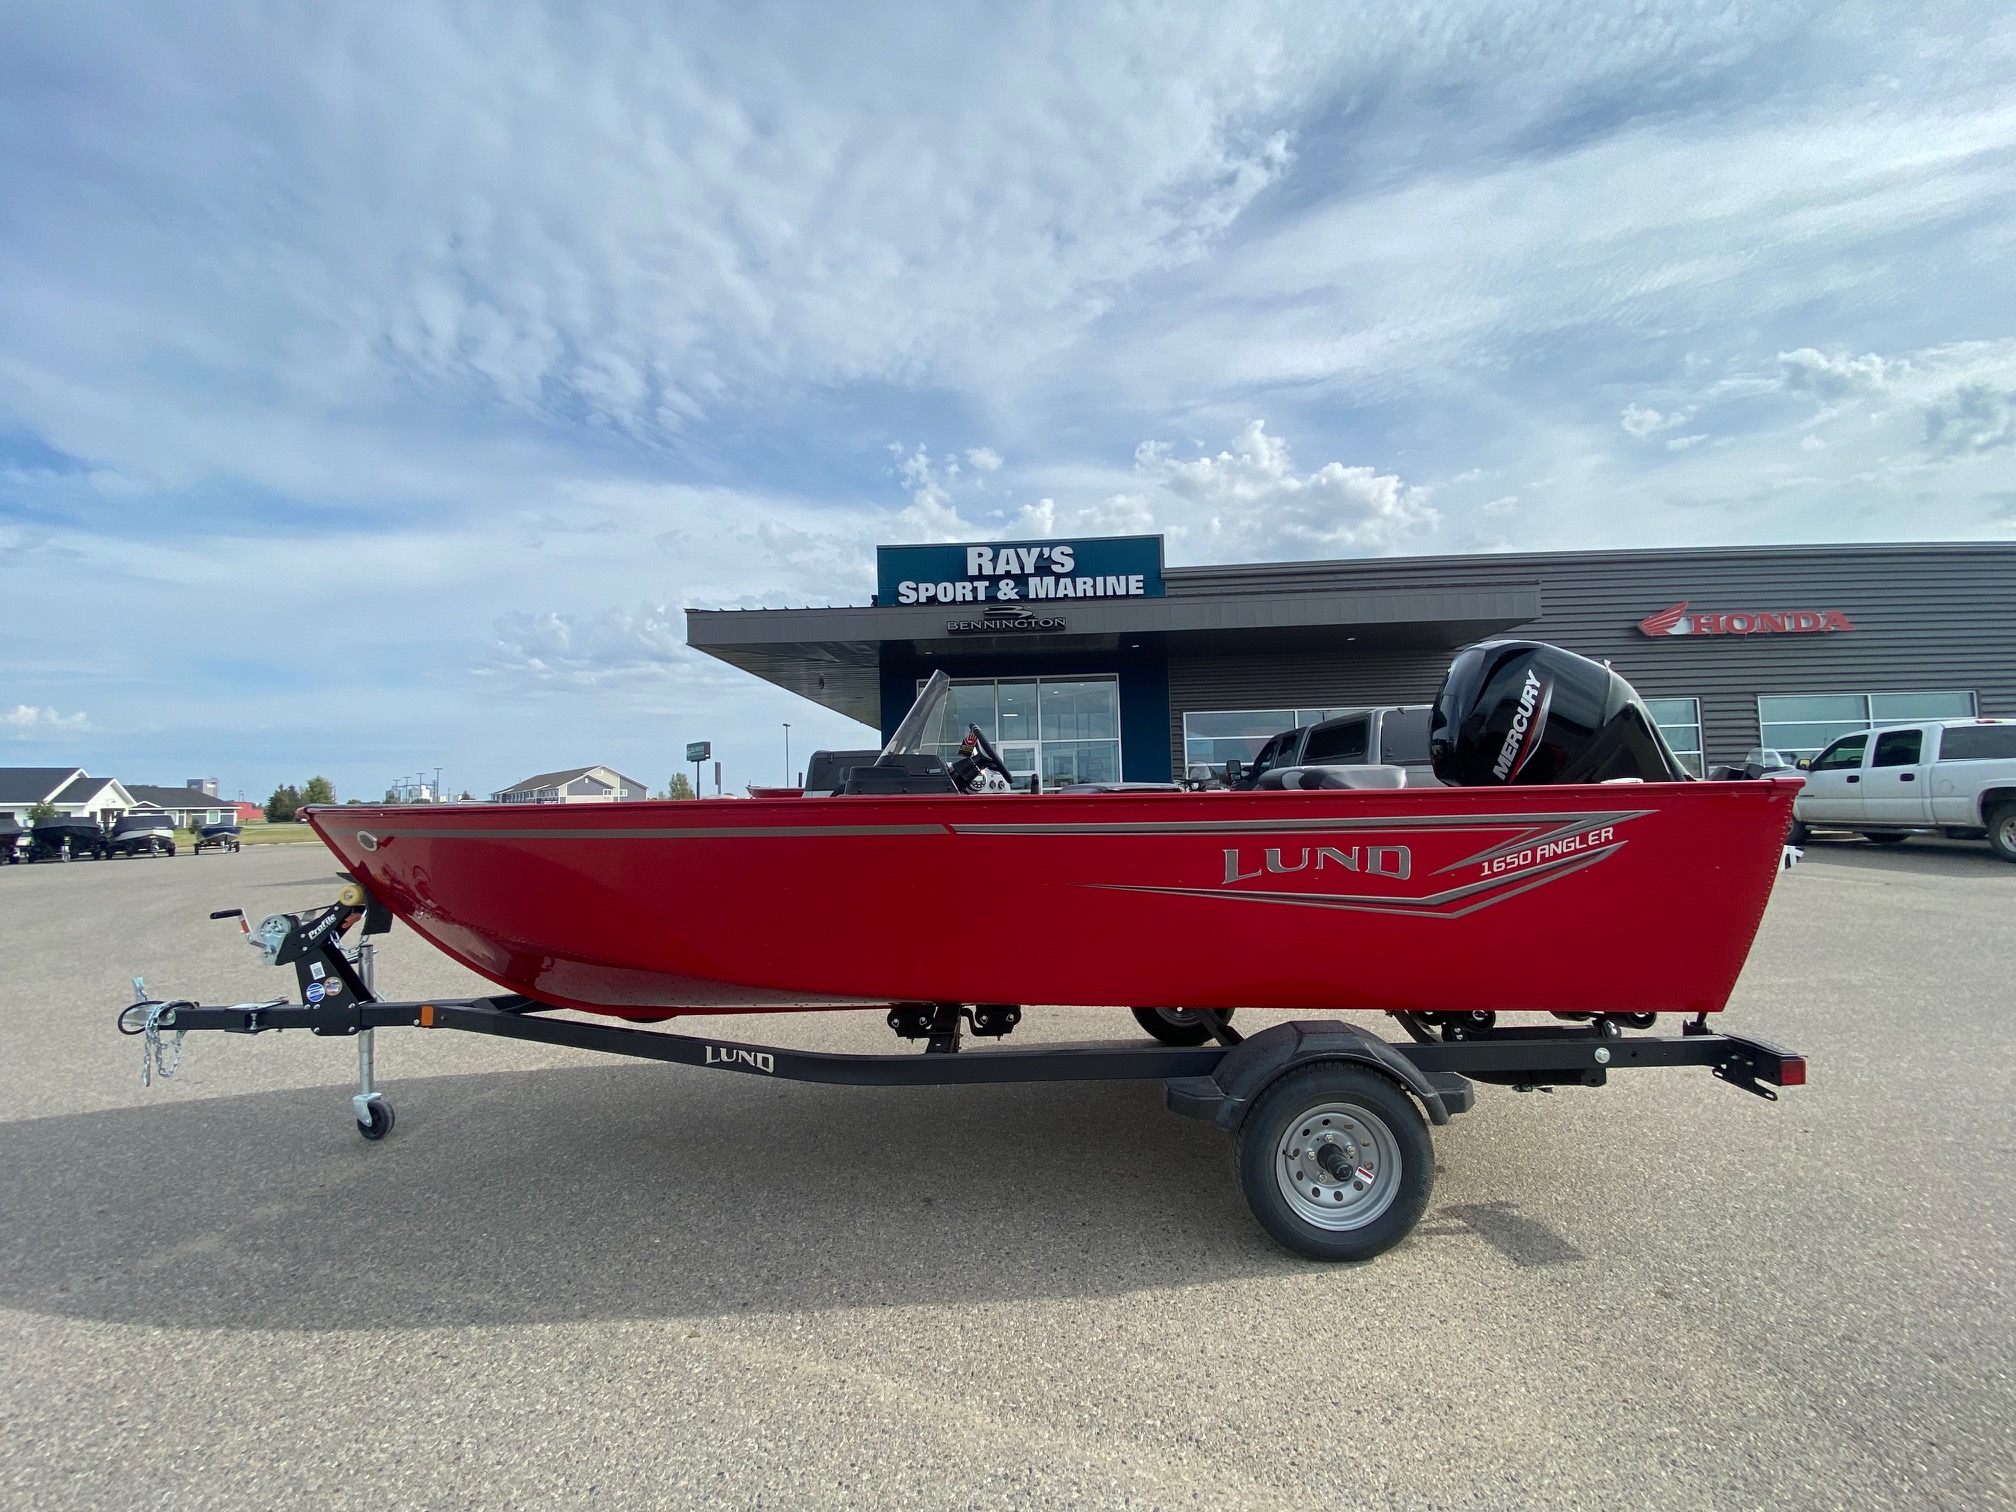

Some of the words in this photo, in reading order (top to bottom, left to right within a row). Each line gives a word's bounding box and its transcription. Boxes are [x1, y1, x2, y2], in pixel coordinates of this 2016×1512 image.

[966, 545, 1075, 576] RAY'S
[898, 581, 990, 604] SPORT
[996, 579, 1019, 600] &
[1028, 575, 1144, 599] MARINE
[947, 616, 1067, 631] BENNINGTON
[1689, 610, 1855, 635] HONDA
[1492, 669, 1541, 780] MERCURY
[1221, 844, 1412, 885] LUND
[1480, 850, 1532, 876] 1650
[1536, 826, 1614, 864] ANGLER
[308, 913, 337, 940] Profile
[704, 1044, 774, 1074] LUND
